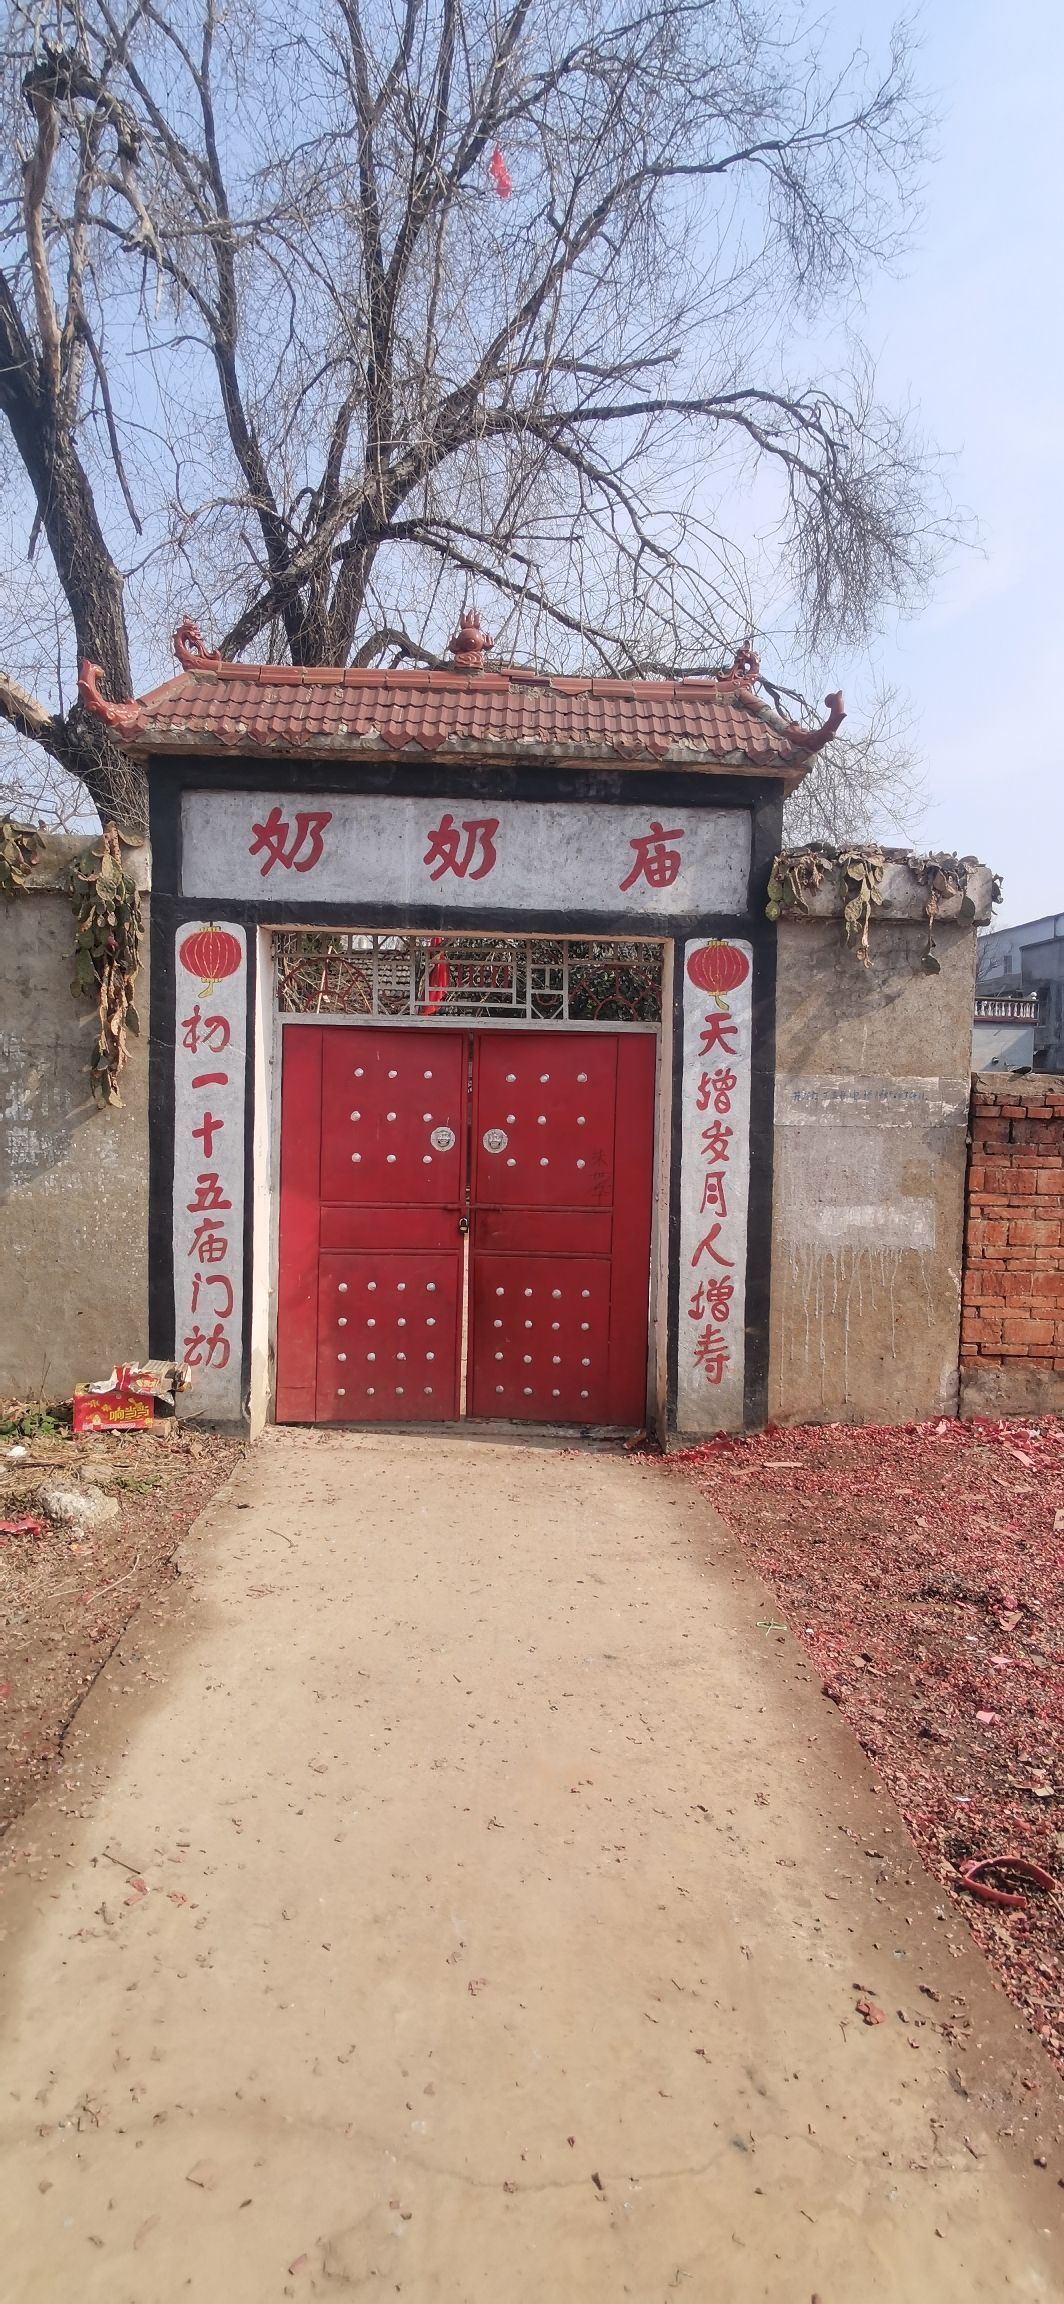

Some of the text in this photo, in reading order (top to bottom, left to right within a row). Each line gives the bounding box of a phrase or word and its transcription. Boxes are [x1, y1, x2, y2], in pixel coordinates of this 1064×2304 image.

[248, 807, 684, 892] 奶奶庙
[688, 1012, 738, 1385] 天增岁月人增寿
